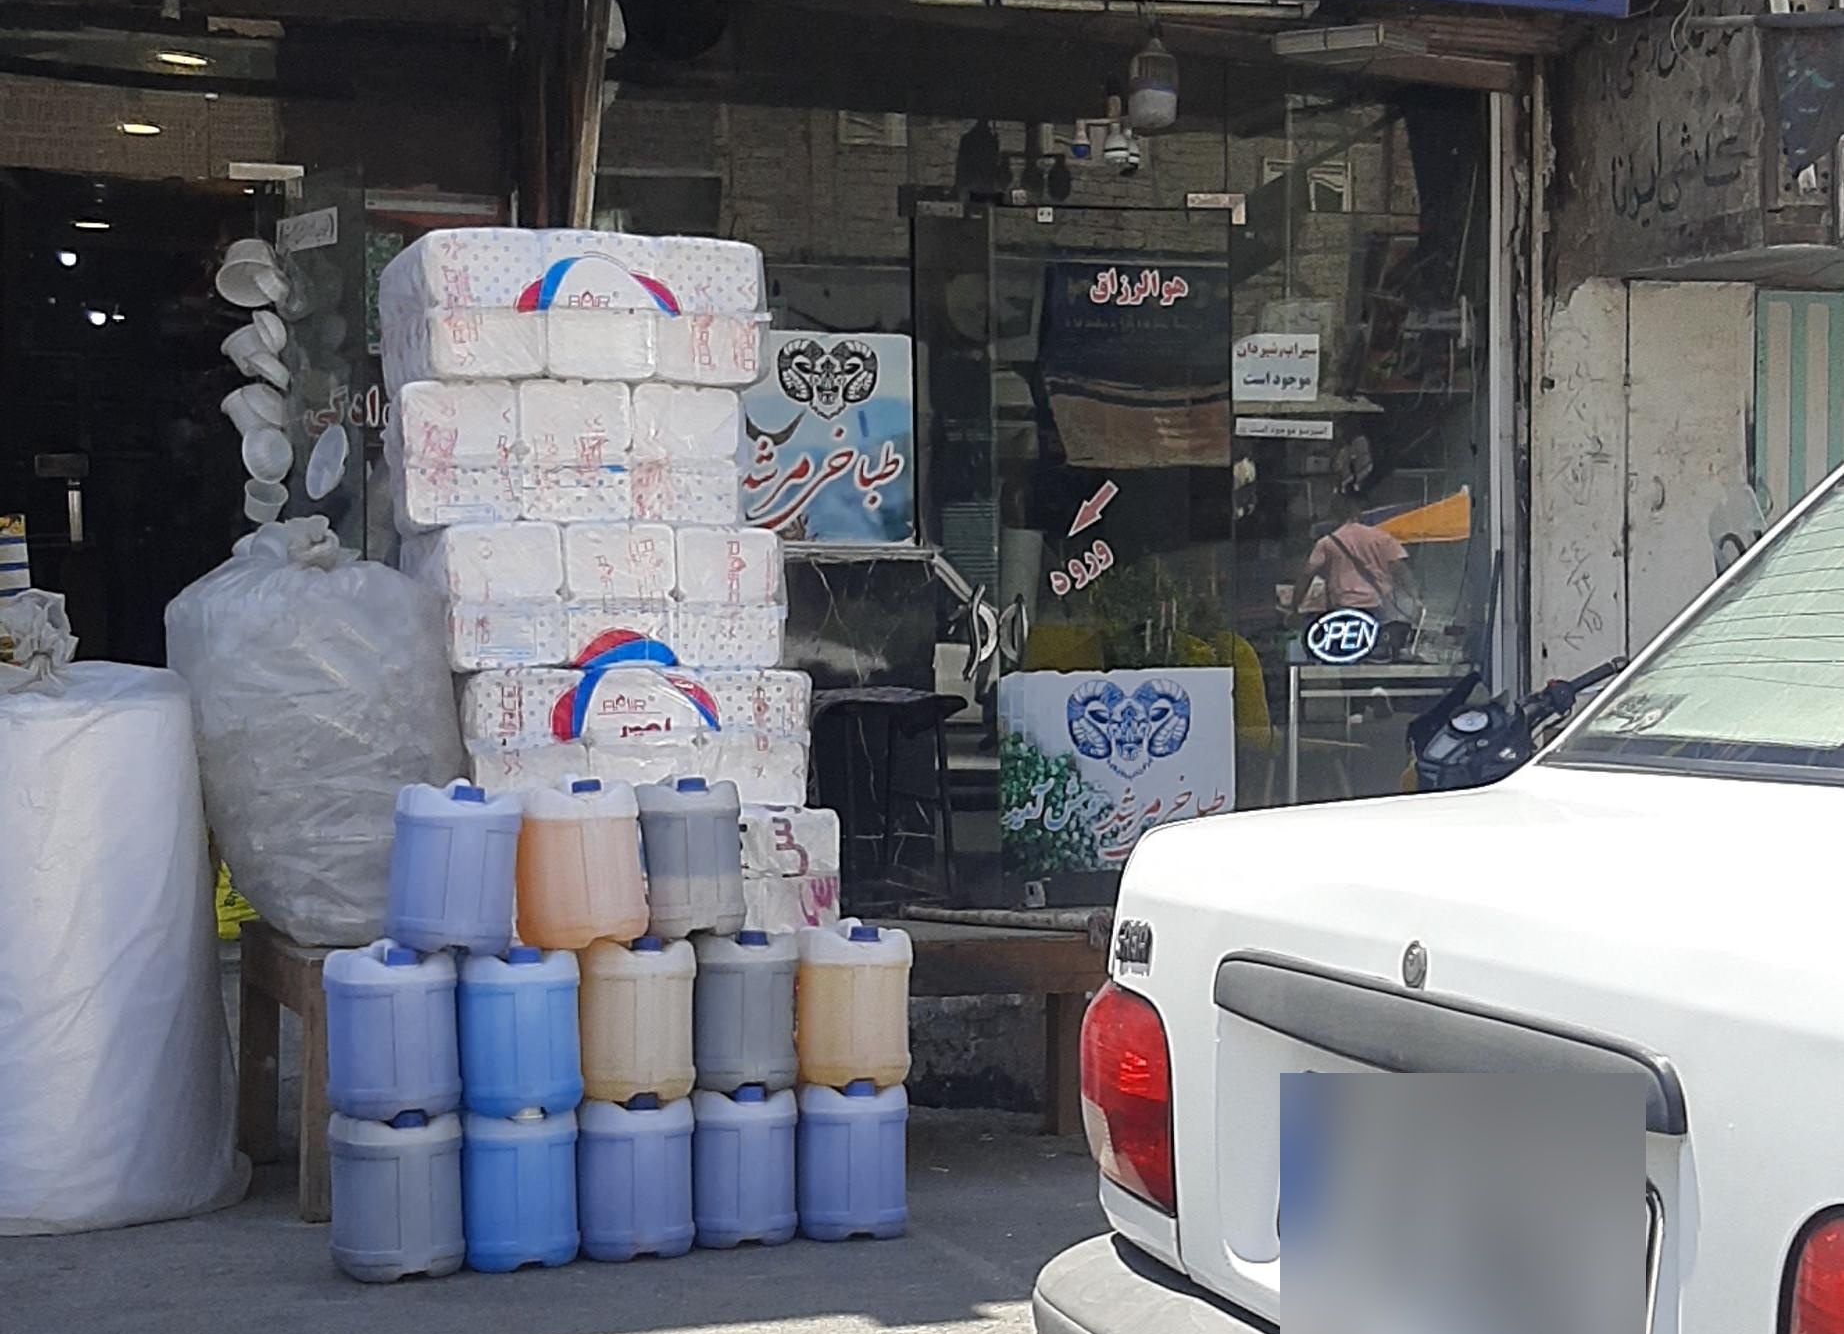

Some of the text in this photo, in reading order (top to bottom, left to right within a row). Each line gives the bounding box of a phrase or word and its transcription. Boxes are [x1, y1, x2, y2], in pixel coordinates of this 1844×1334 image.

[1243, 371, 1311, 390] موجود است
[1049, 539, 1114, 596] ورود
[1307, 619, 1380, 651] OPEN
